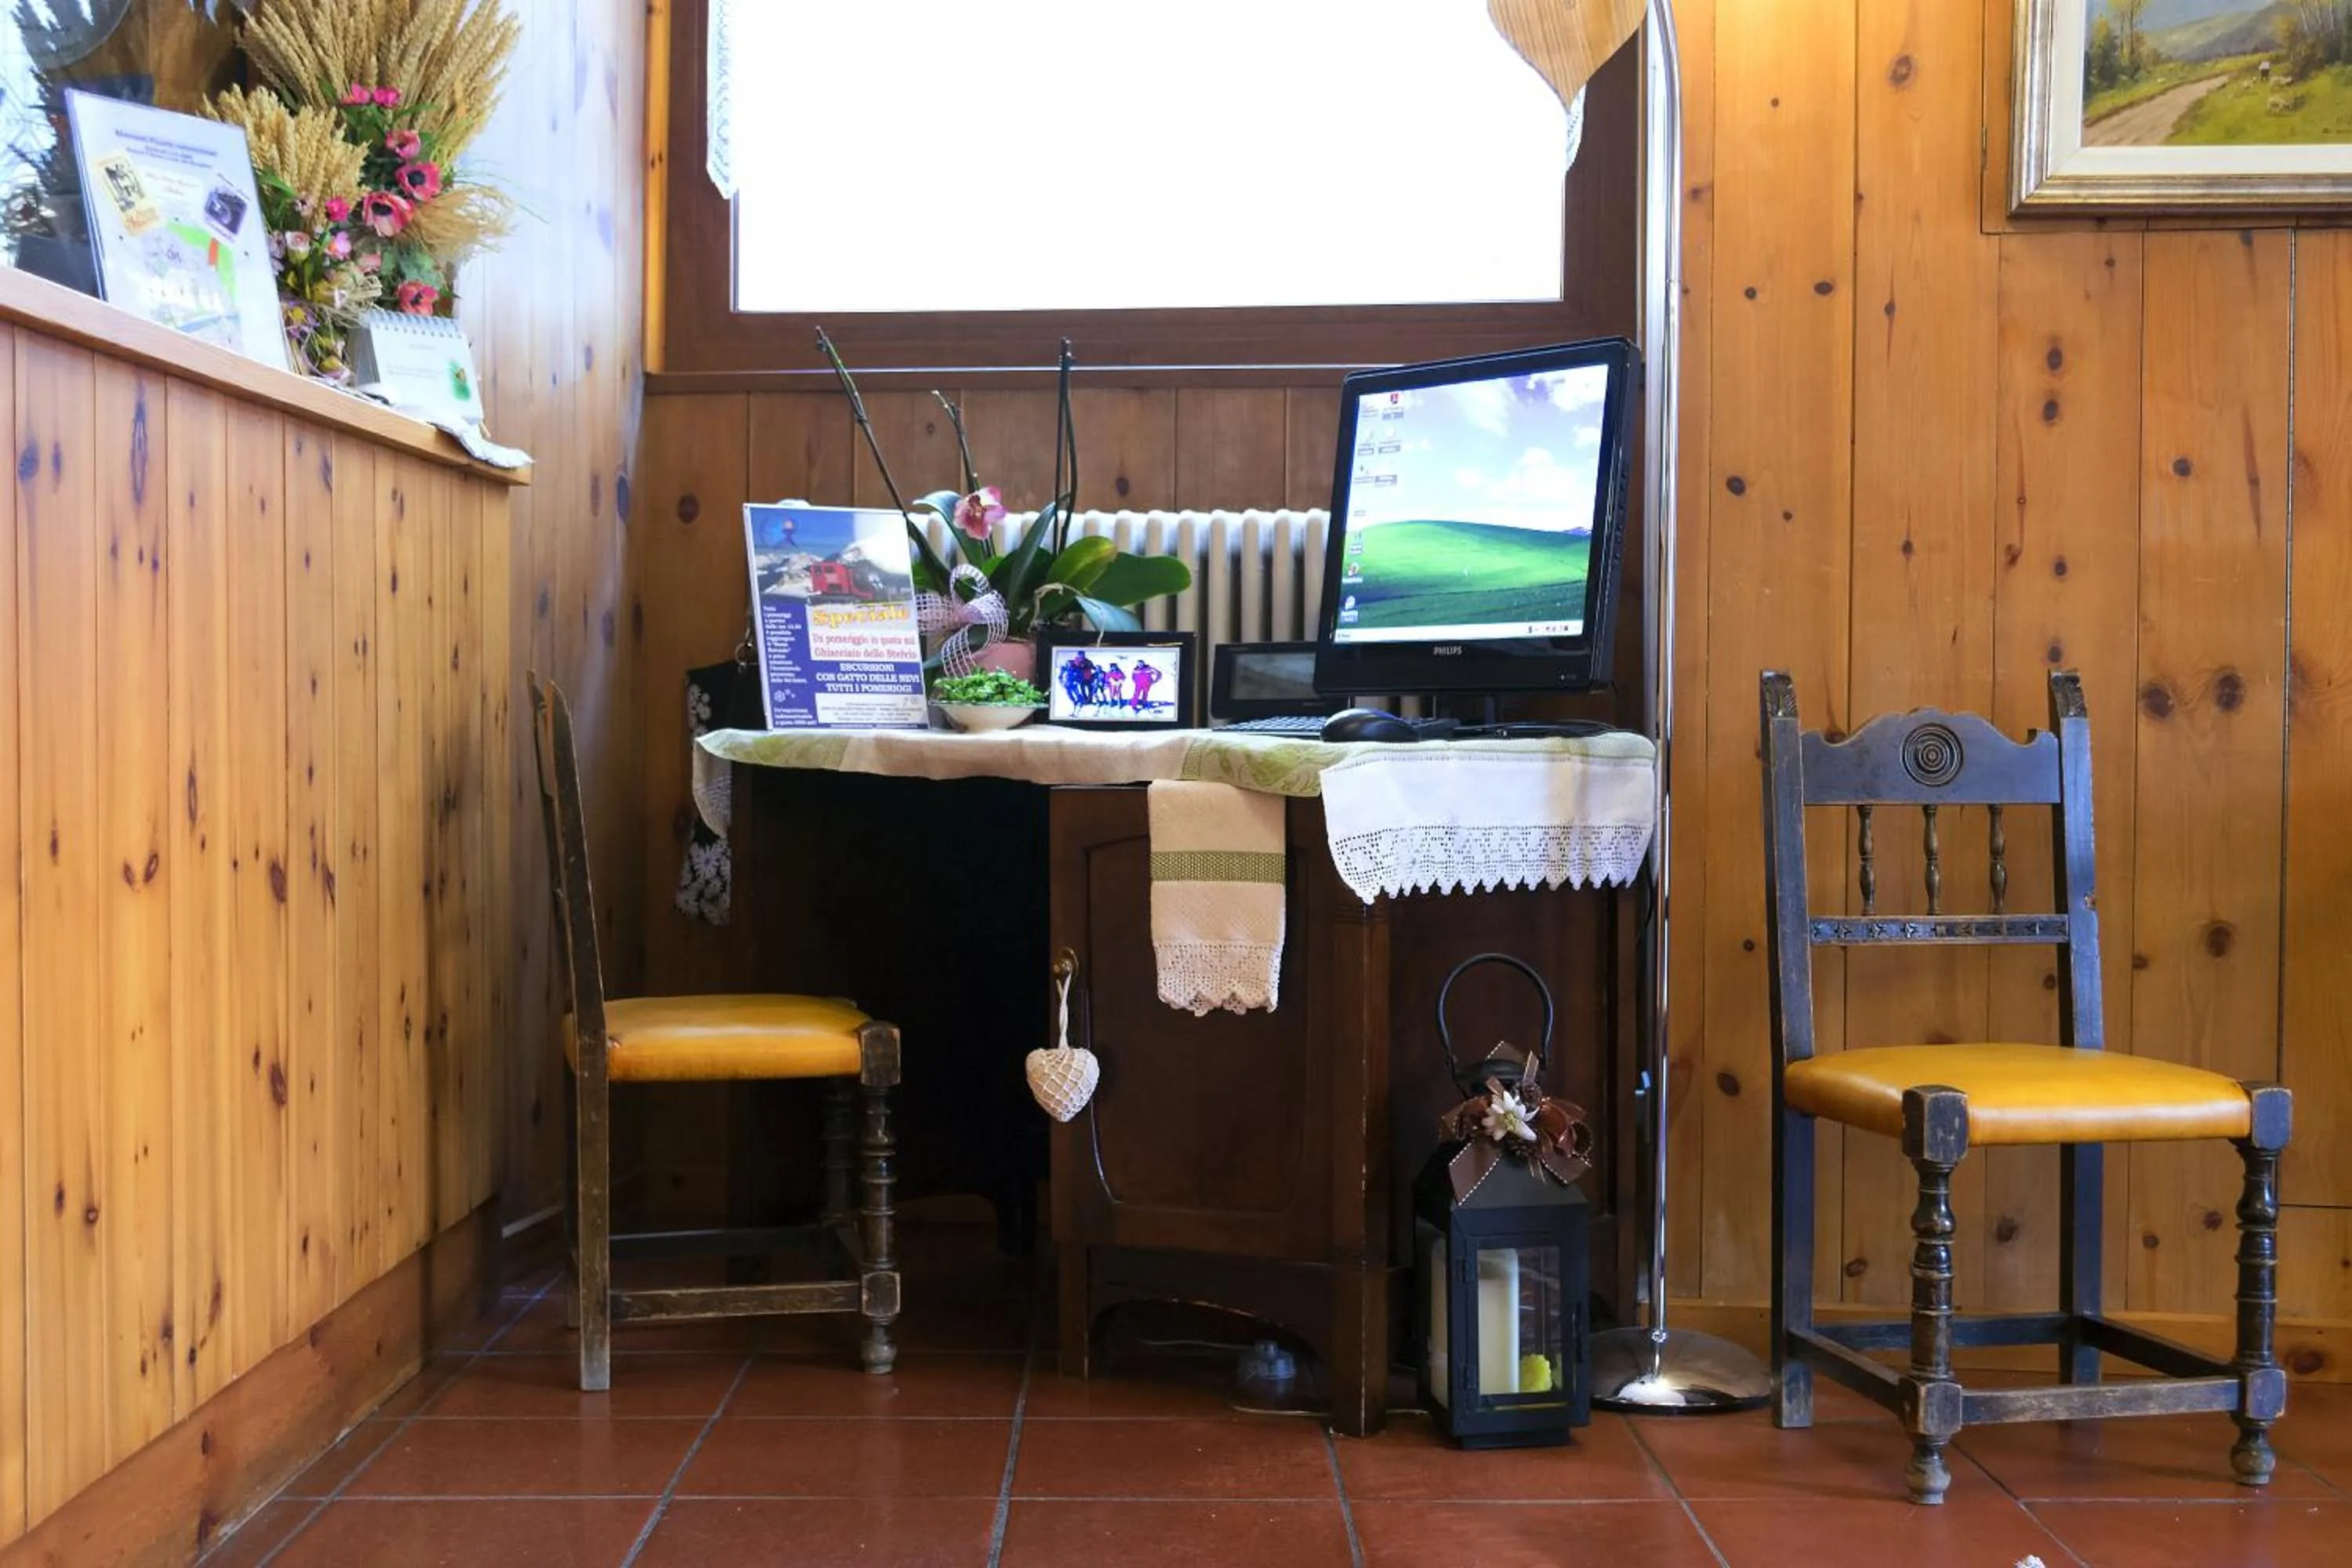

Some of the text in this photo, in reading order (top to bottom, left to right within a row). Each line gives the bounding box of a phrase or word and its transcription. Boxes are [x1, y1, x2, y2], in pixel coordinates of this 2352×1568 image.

[1433, 646, 1462, 655] PHILIPS
[840, 663, 895, 672] ESCURSIONI
[837, 673, 868, 682] GATTO
[868, 674, 898, 683] DELLE
[826, 683, 855, 692] TUTTI
